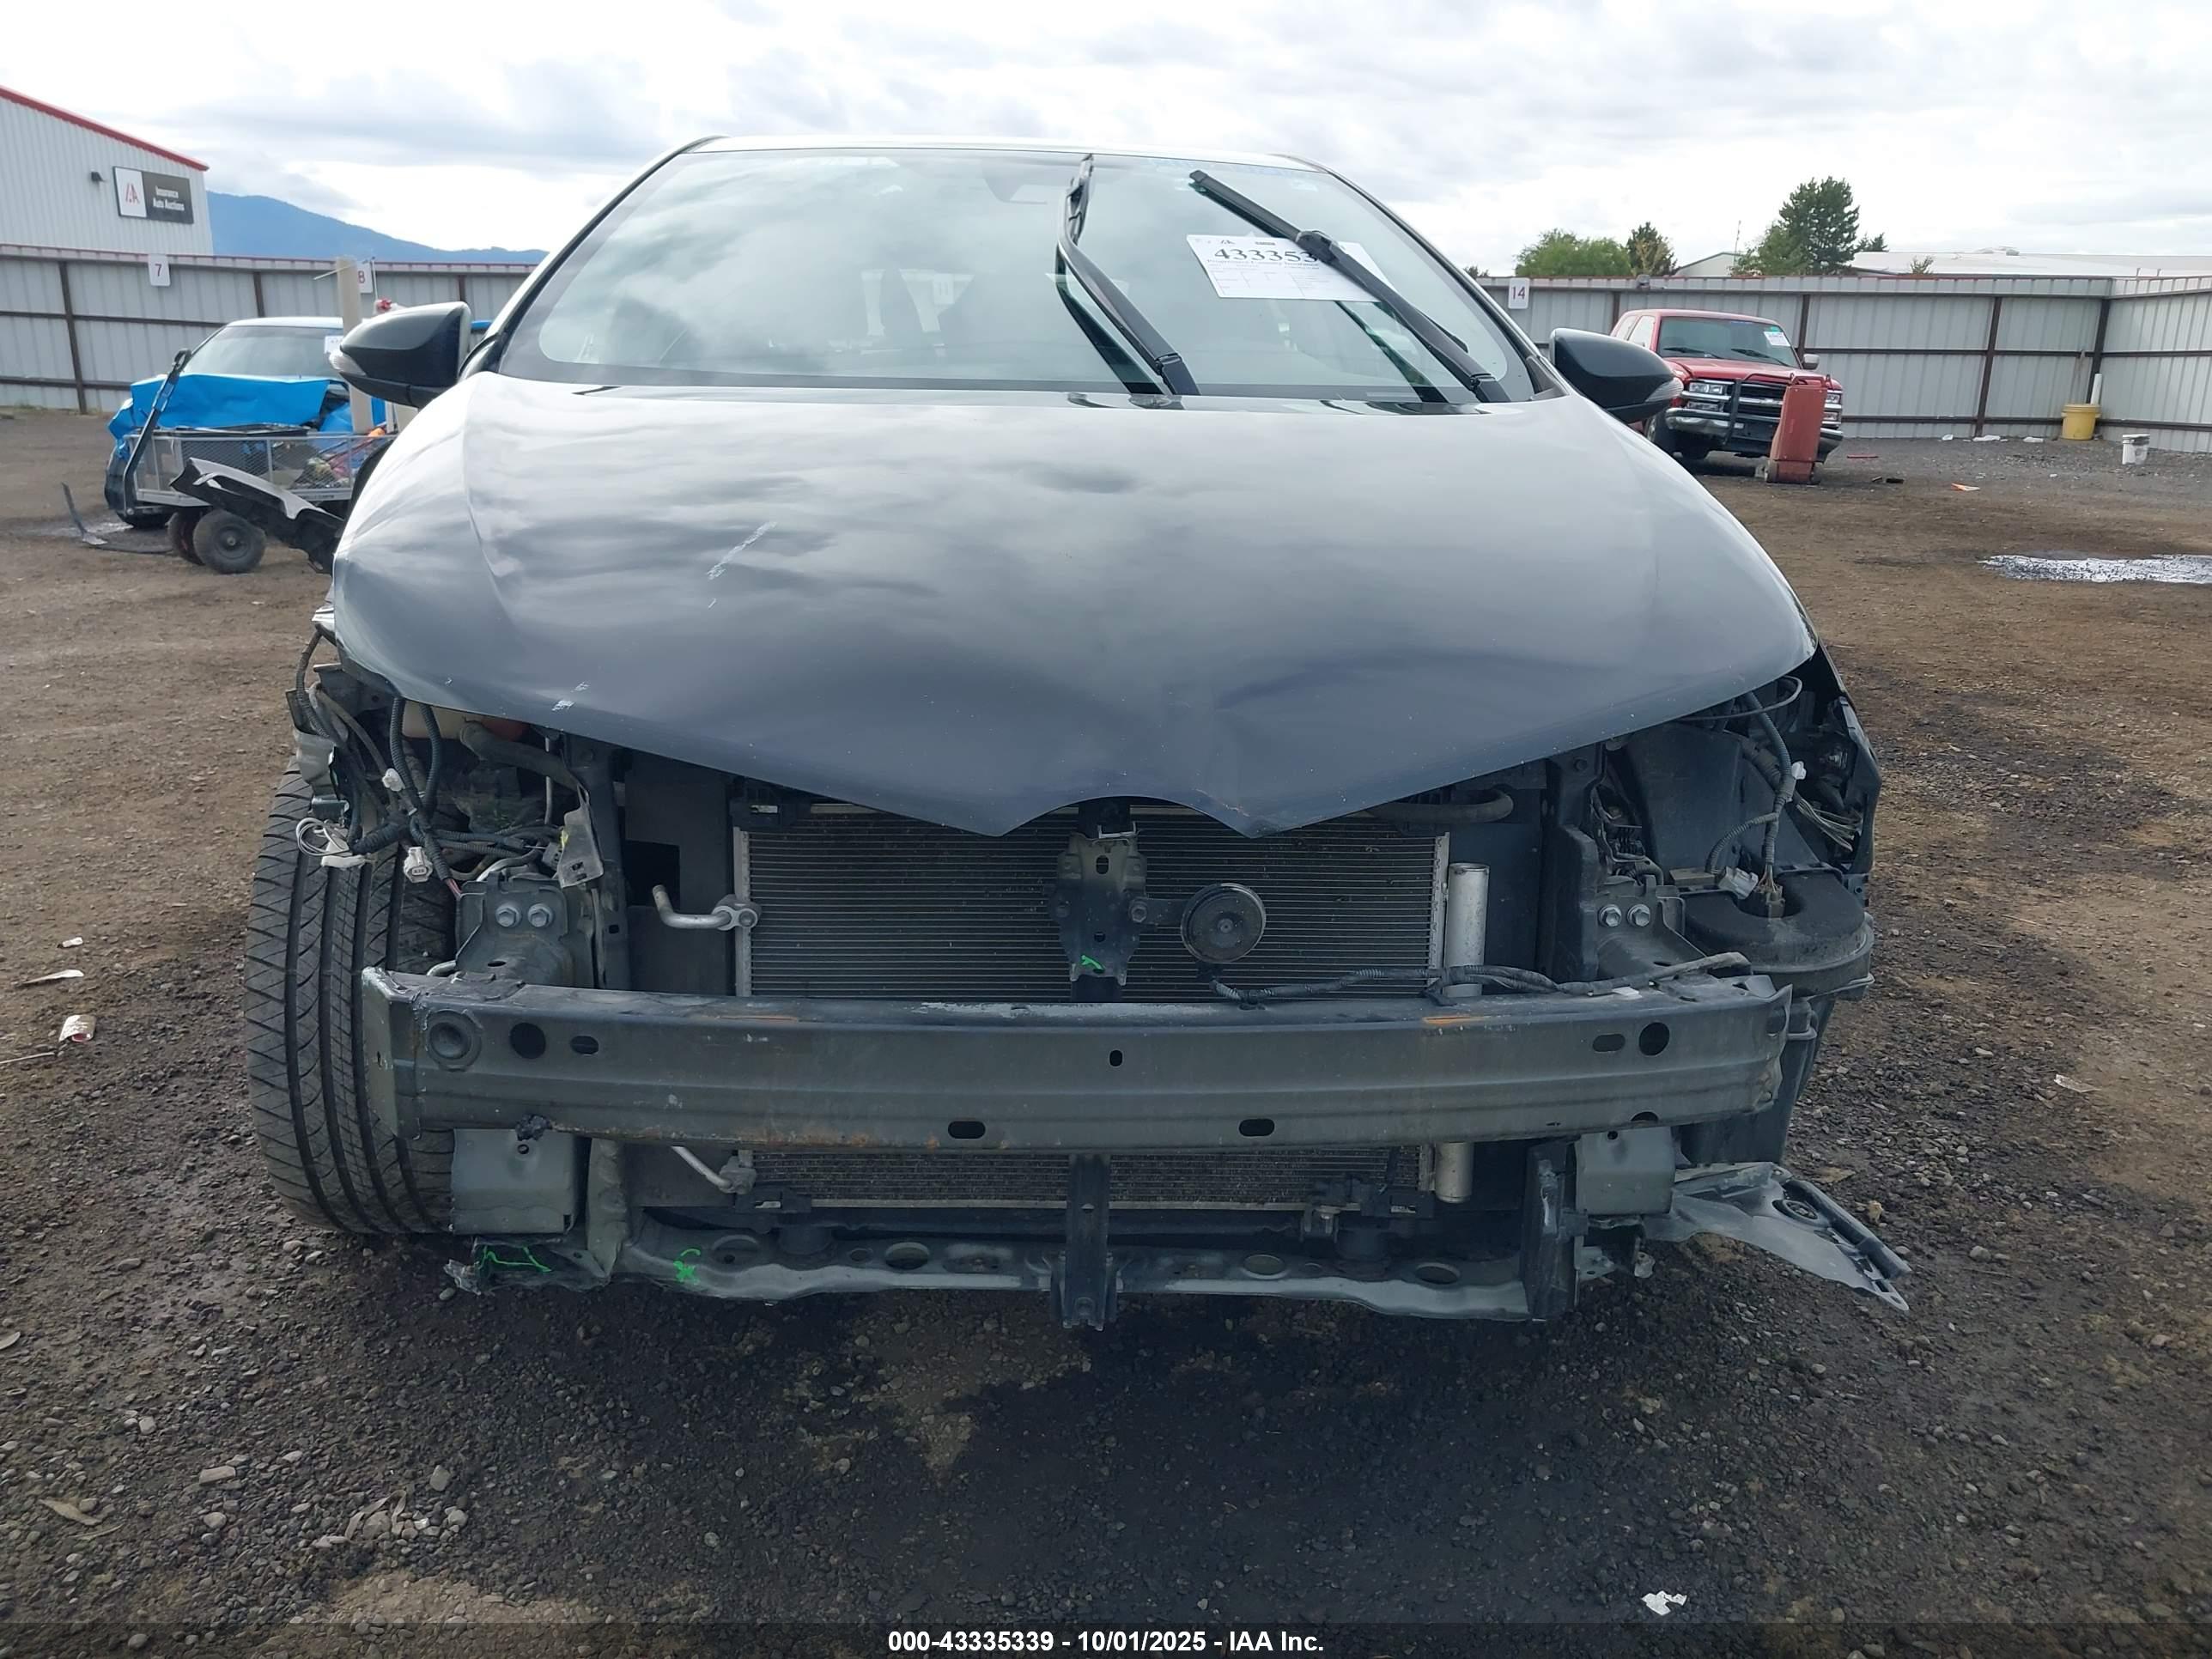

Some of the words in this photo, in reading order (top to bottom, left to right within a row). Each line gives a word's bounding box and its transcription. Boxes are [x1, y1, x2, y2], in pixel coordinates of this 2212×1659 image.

[1214, 248, 1318, 263] 433353
[155, 263, 162, 276] 7
[1511, 286, 1526, 300] 14
